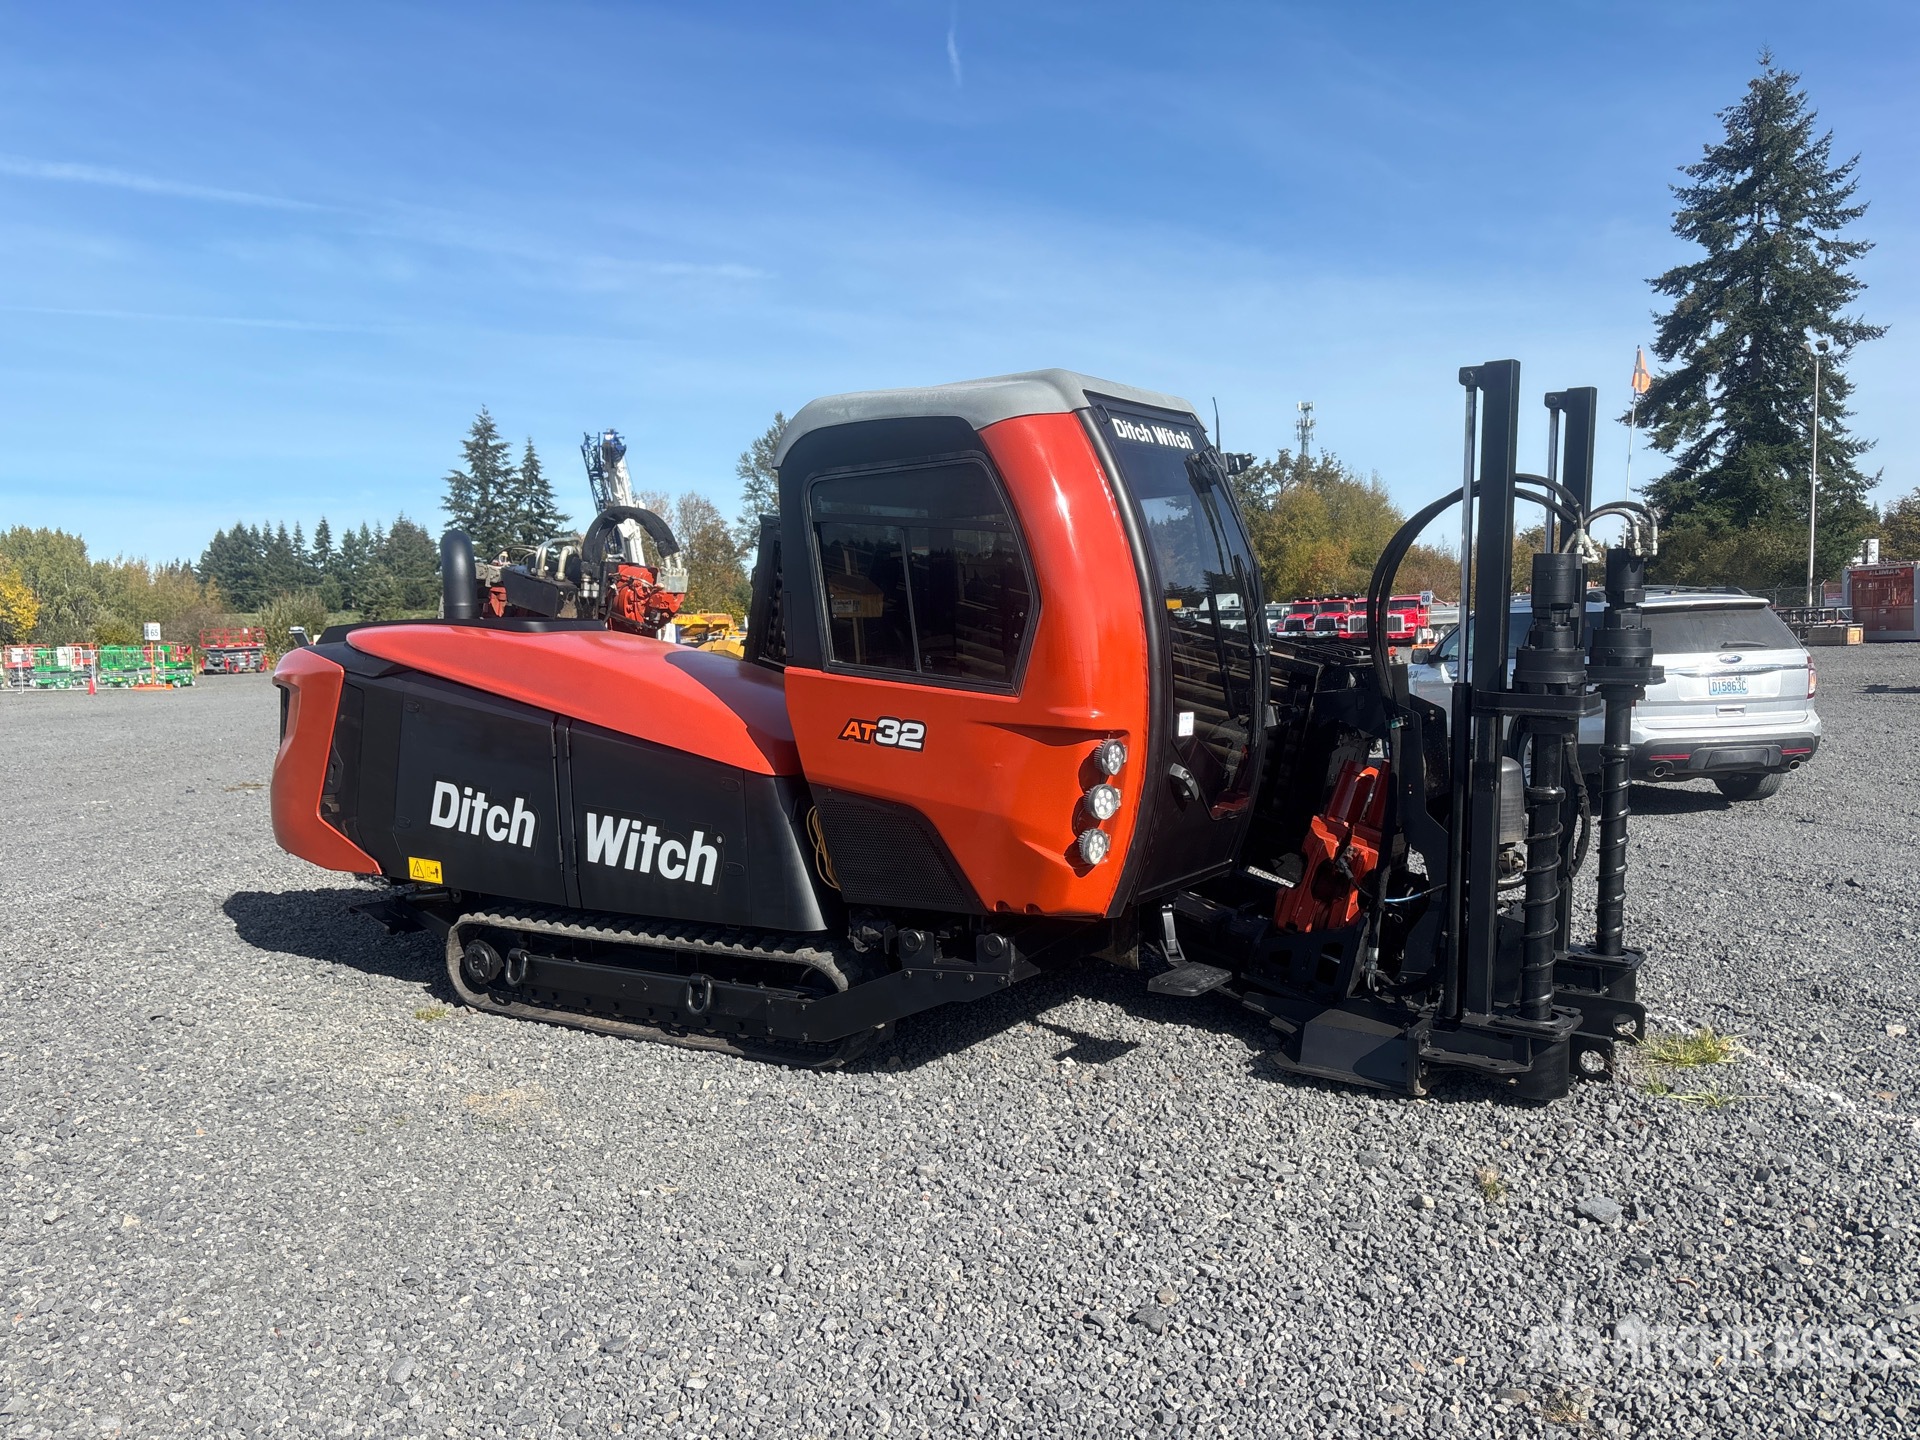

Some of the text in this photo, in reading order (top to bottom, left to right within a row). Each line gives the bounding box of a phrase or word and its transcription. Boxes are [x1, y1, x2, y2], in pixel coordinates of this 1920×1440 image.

[1111, 418, 1194, 449] Ditch Witch
[1711, 680, 1747, 692] D15863C
[841, 718, 925, 749] AT32
[429, 780, 718, 886] Ditch Witch
